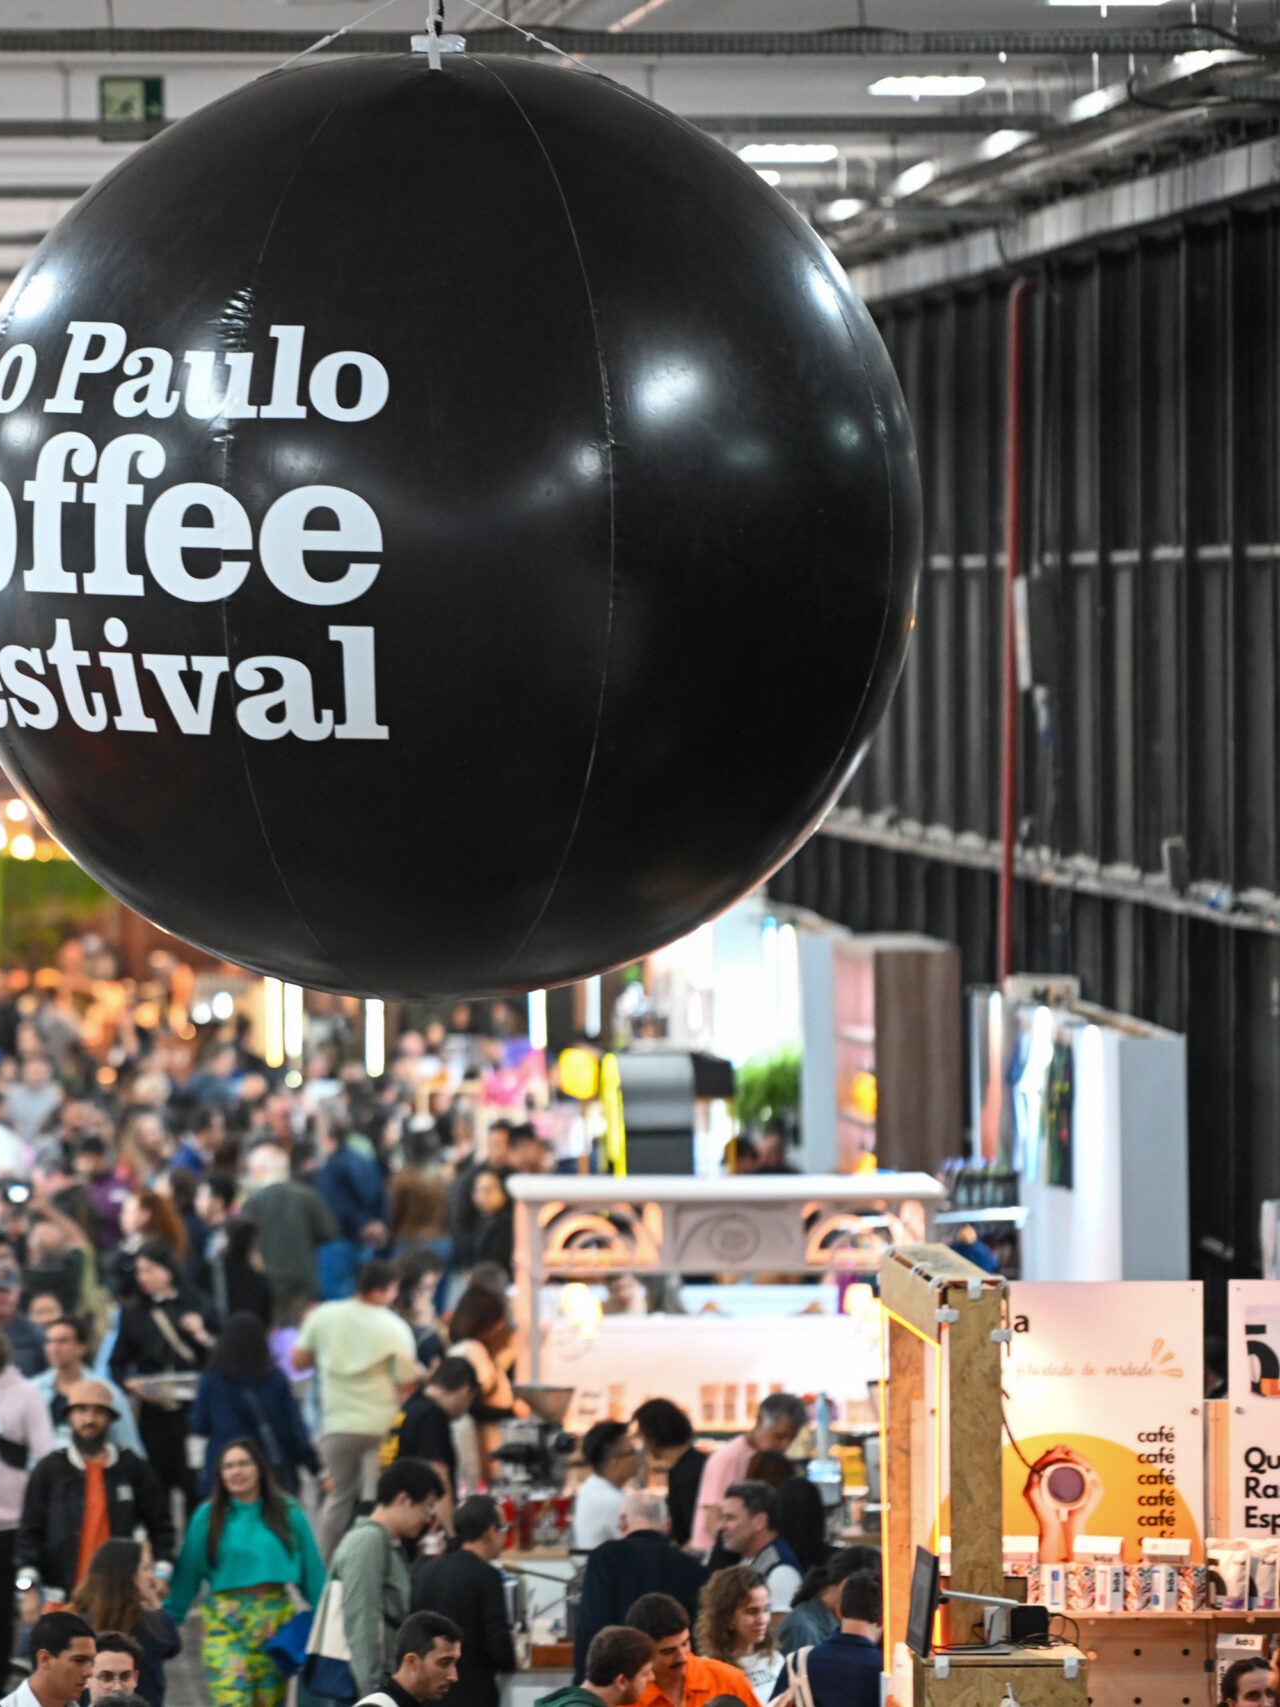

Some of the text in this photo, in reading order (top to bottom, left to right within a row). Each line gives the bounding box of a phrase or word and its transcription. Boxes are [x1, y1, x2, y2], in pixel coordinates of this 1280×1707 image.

[43, 320, 390, 422] Paulo
[1137, 1425, 1176, 1443] café
[1137, 1446, 1176, 1464] café
[1137, 1467, 1176, 1485] café
[1244, 1476, 1280, 1499] Ra
[1137, 1488, 1176, 1506] café
[1137, 1509, 1176, 1527] café
